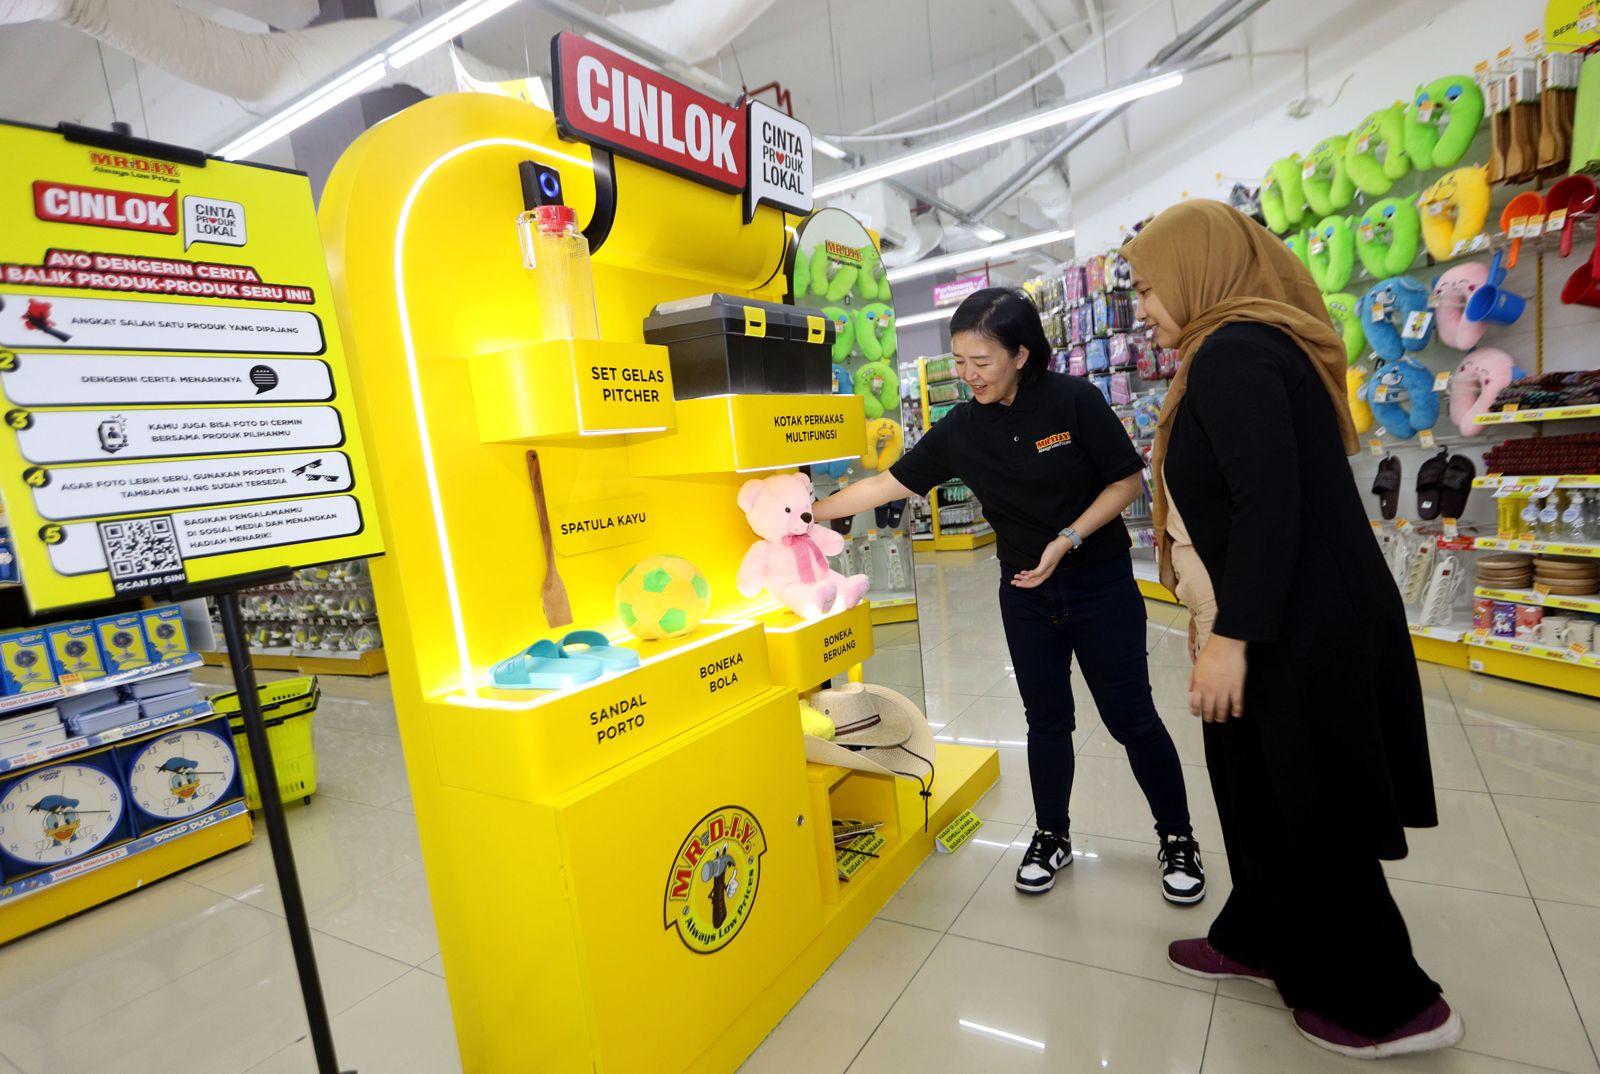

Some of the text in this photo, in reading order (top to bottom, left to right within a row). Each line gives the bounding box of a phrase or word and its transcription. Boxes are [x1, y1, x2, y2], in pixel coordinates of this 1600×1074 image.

[577, 55, 738, 175] CINLOK
[763, 121, 804, 158] CINTA
[763, 162, 804, 195] LOKAL
[44, 188, 171, 227] CINLOK
[195, 204, 236, 219] CINTA
[197, 223, 237, 237] LOKAL
[51, 253, 257, 281] AYO DENGERIN CERITA
[7, 267, 73, 284] BALIK
[76, 273, 239, 295] PRODUK-PRODUK
[240, 286, 283, 298] SERU
[286, 291, 311, 301] INI!
[72, 317, 116, 325] ANGKAT
[120, 319, 156, 327] SALAH
[256, 326, 299, 334] DIPAJANG
[0, 353, 14, 369] 2
[592, 367, 664, 382] SET GELAS
[603, 388, 659, 402] PITCHER
[12, 411, 30, 430] 3
[149, 423, 178, 431] KAMU
[774, 414, 844, 427] KOTAK PERKAKAS
[152, 430, 291, 442] BERSAMA PRODUK PILIHANMU
[786, 430, 837, 443] MULTIFUNGSI
[27, 469, 46, 487] 4
[96, 480, 126, 488] FOTO
[162, 475, 191, 483] SERU,
[194, 471, 240, 480] GUNAKAN
[243, 468, 284, 476] PROPERTI
[121, 478, 288, 498] TAMBAHAN YANG SUDAH TERSEDIA
[184, 507, 302, 526] BAGIKAN PENGALAMANMU
[200, 526, 233, 536] SOSIAL
[235, 522, 263, 531] MEDIA
[265, 519, 284, 527] DAN
[286, 513, 338, 524] MENANGKAN
[561, 513, 646, 535] SPATULA KAYU
[44, 526, 62, 544] 5
[190, 532, 272, 548] HADIAH MENARIK!
[115, 573, 185, 591] SCAN DI SINI
[824, 627, 852, 647] BONEKA
[823, 639, 856, 662] BERUANG
[144, 661, 170, 674] DUCK
[700, 653, 743, 678] BONEKA
[709, 672, 738, 693] BOLA
[154, 712, 180, 725] DUCK
[590, 694, 647, 725] SANDAL
[597, 714, 645, 744] PORTO
[77, 768, 83, 776] 1
[98, 777, 106, 785] 2
[19, 783, 30, 792] 11
[110, 793, 118, 801] 3
[1, 802, 14, 812] 10
[154, 826, 187, 843] DONALD
[189, 815, 216, 829] DUCK
[65, 847, 72, 856] 6
[685, 869, 754, 945] Always Low Prices
